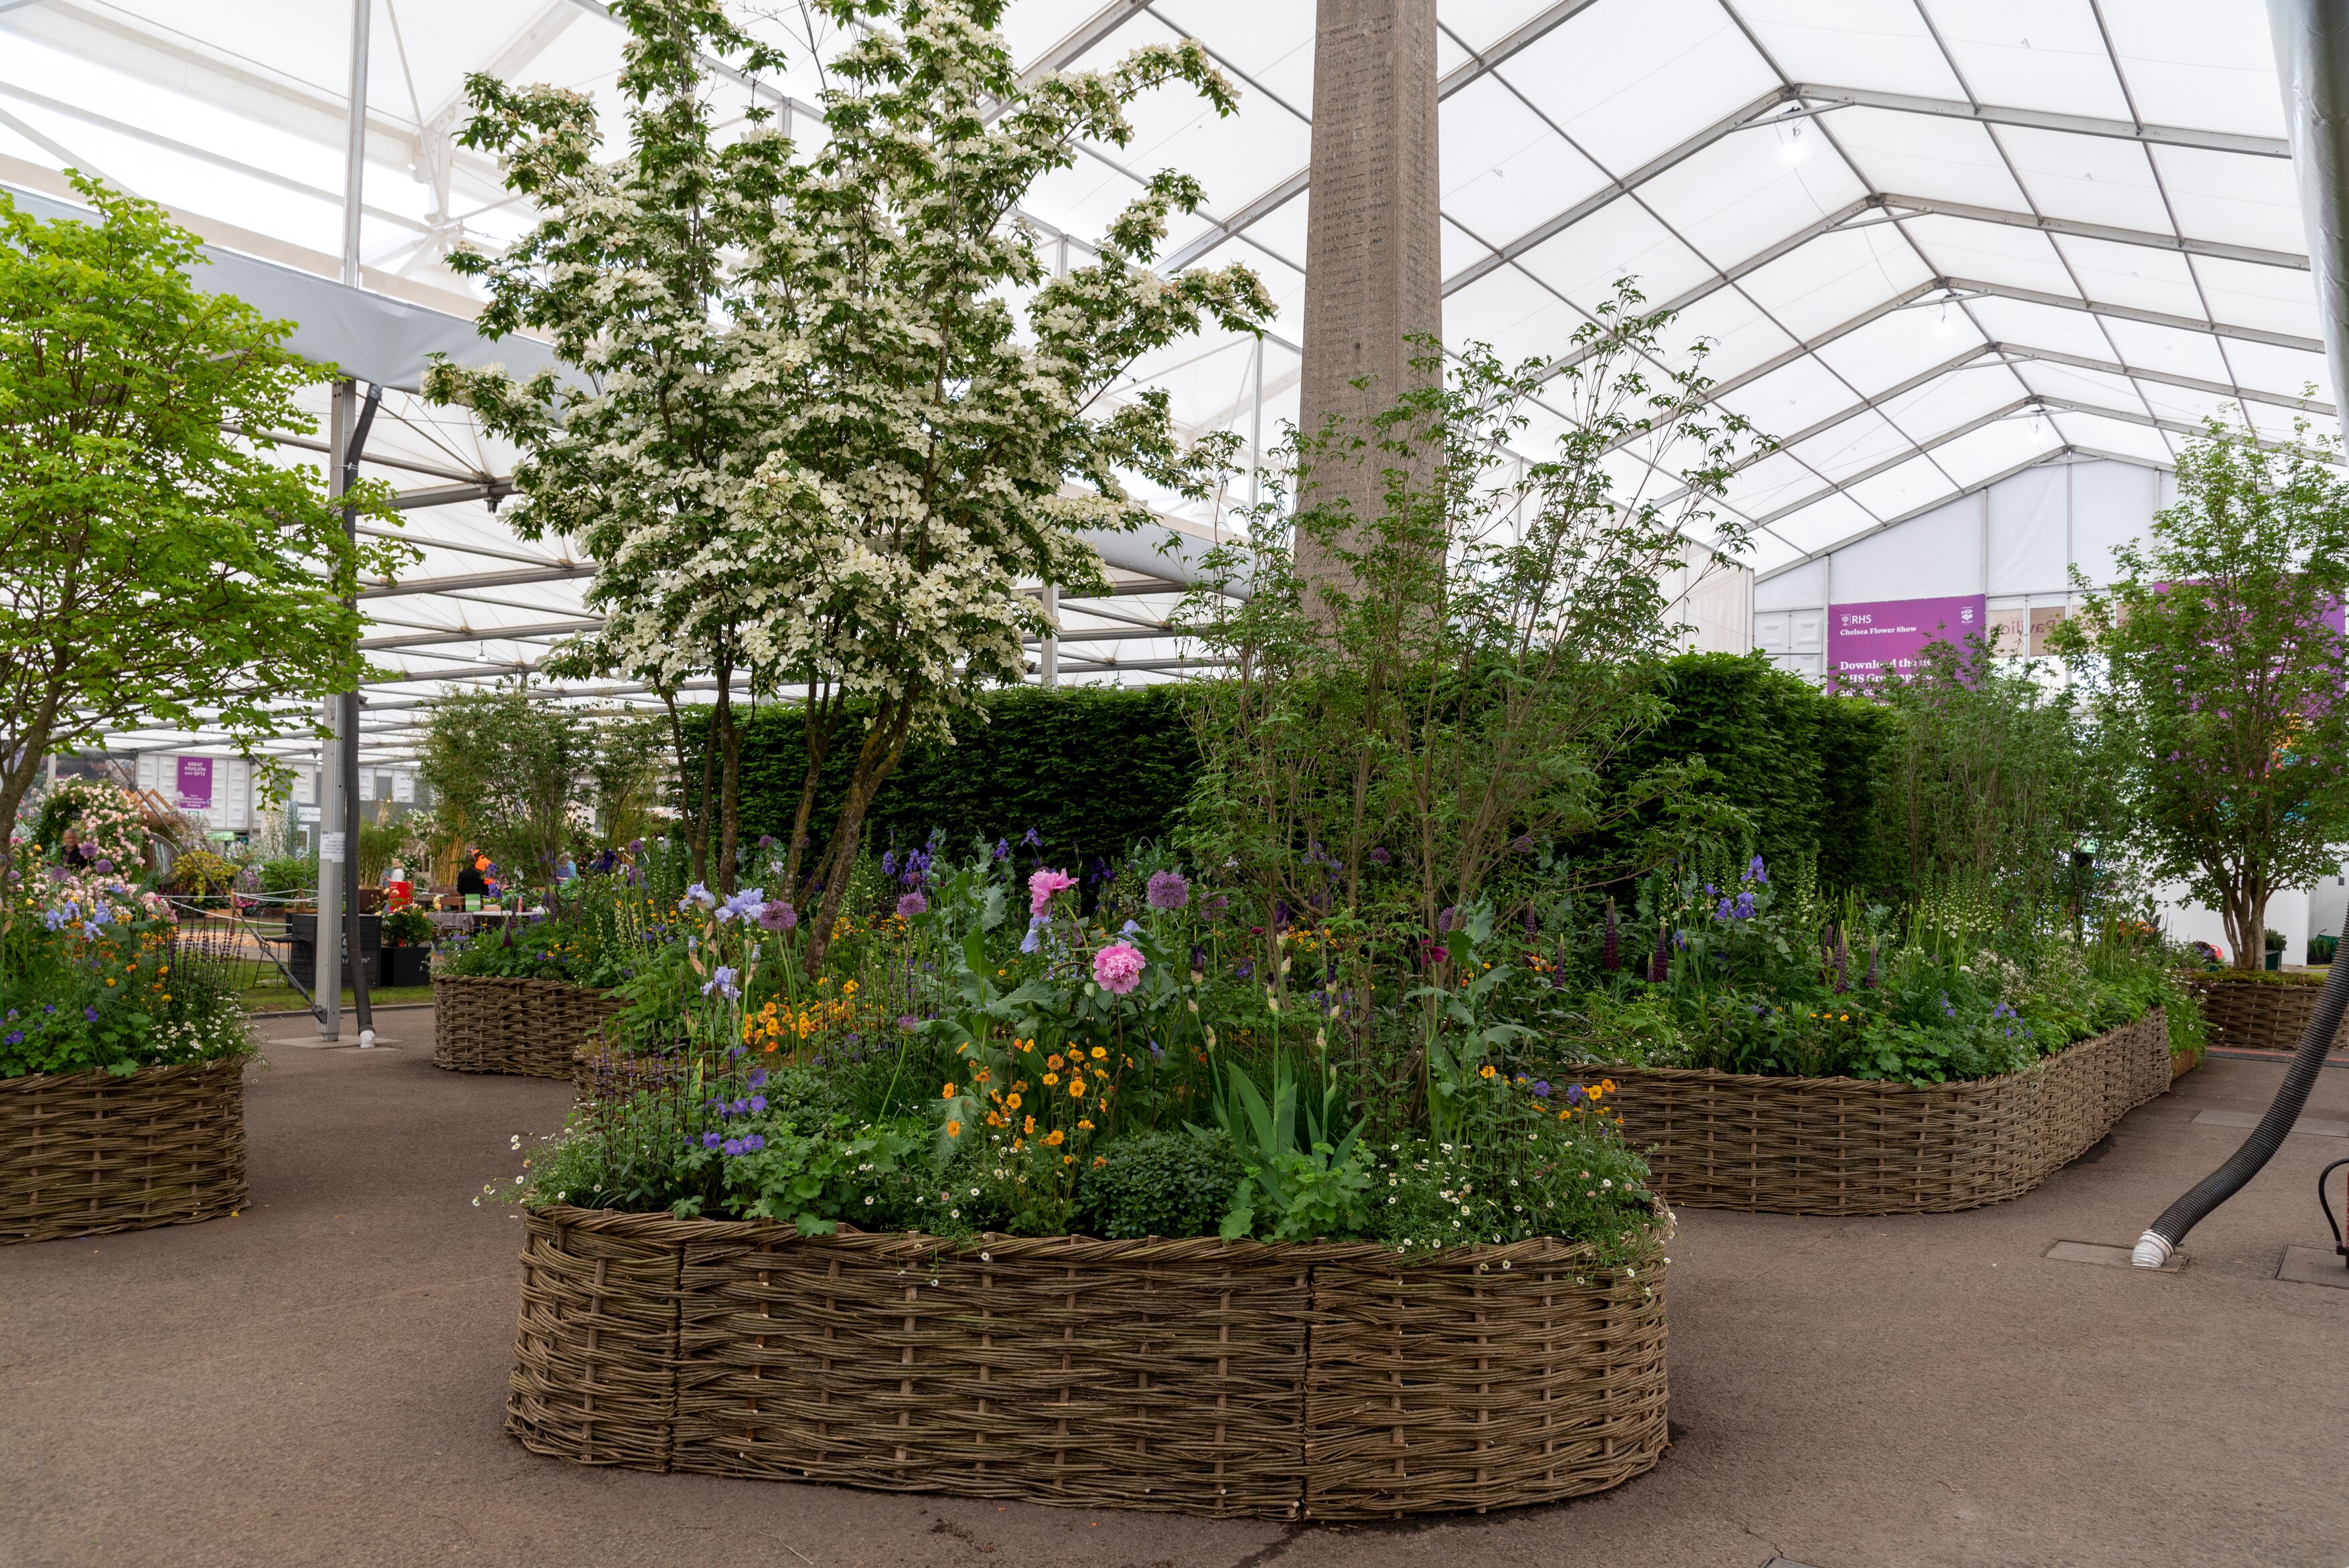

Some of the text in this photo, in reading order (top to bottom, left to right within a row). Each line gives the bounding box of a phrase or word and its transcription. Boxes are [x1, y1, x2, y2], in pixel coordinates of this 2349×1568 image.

[1851, 615, 1872, 624] RHS
[1840, 628, 1868, 636] Chelsea
[1839, 659, 1897, 670] Downlod
